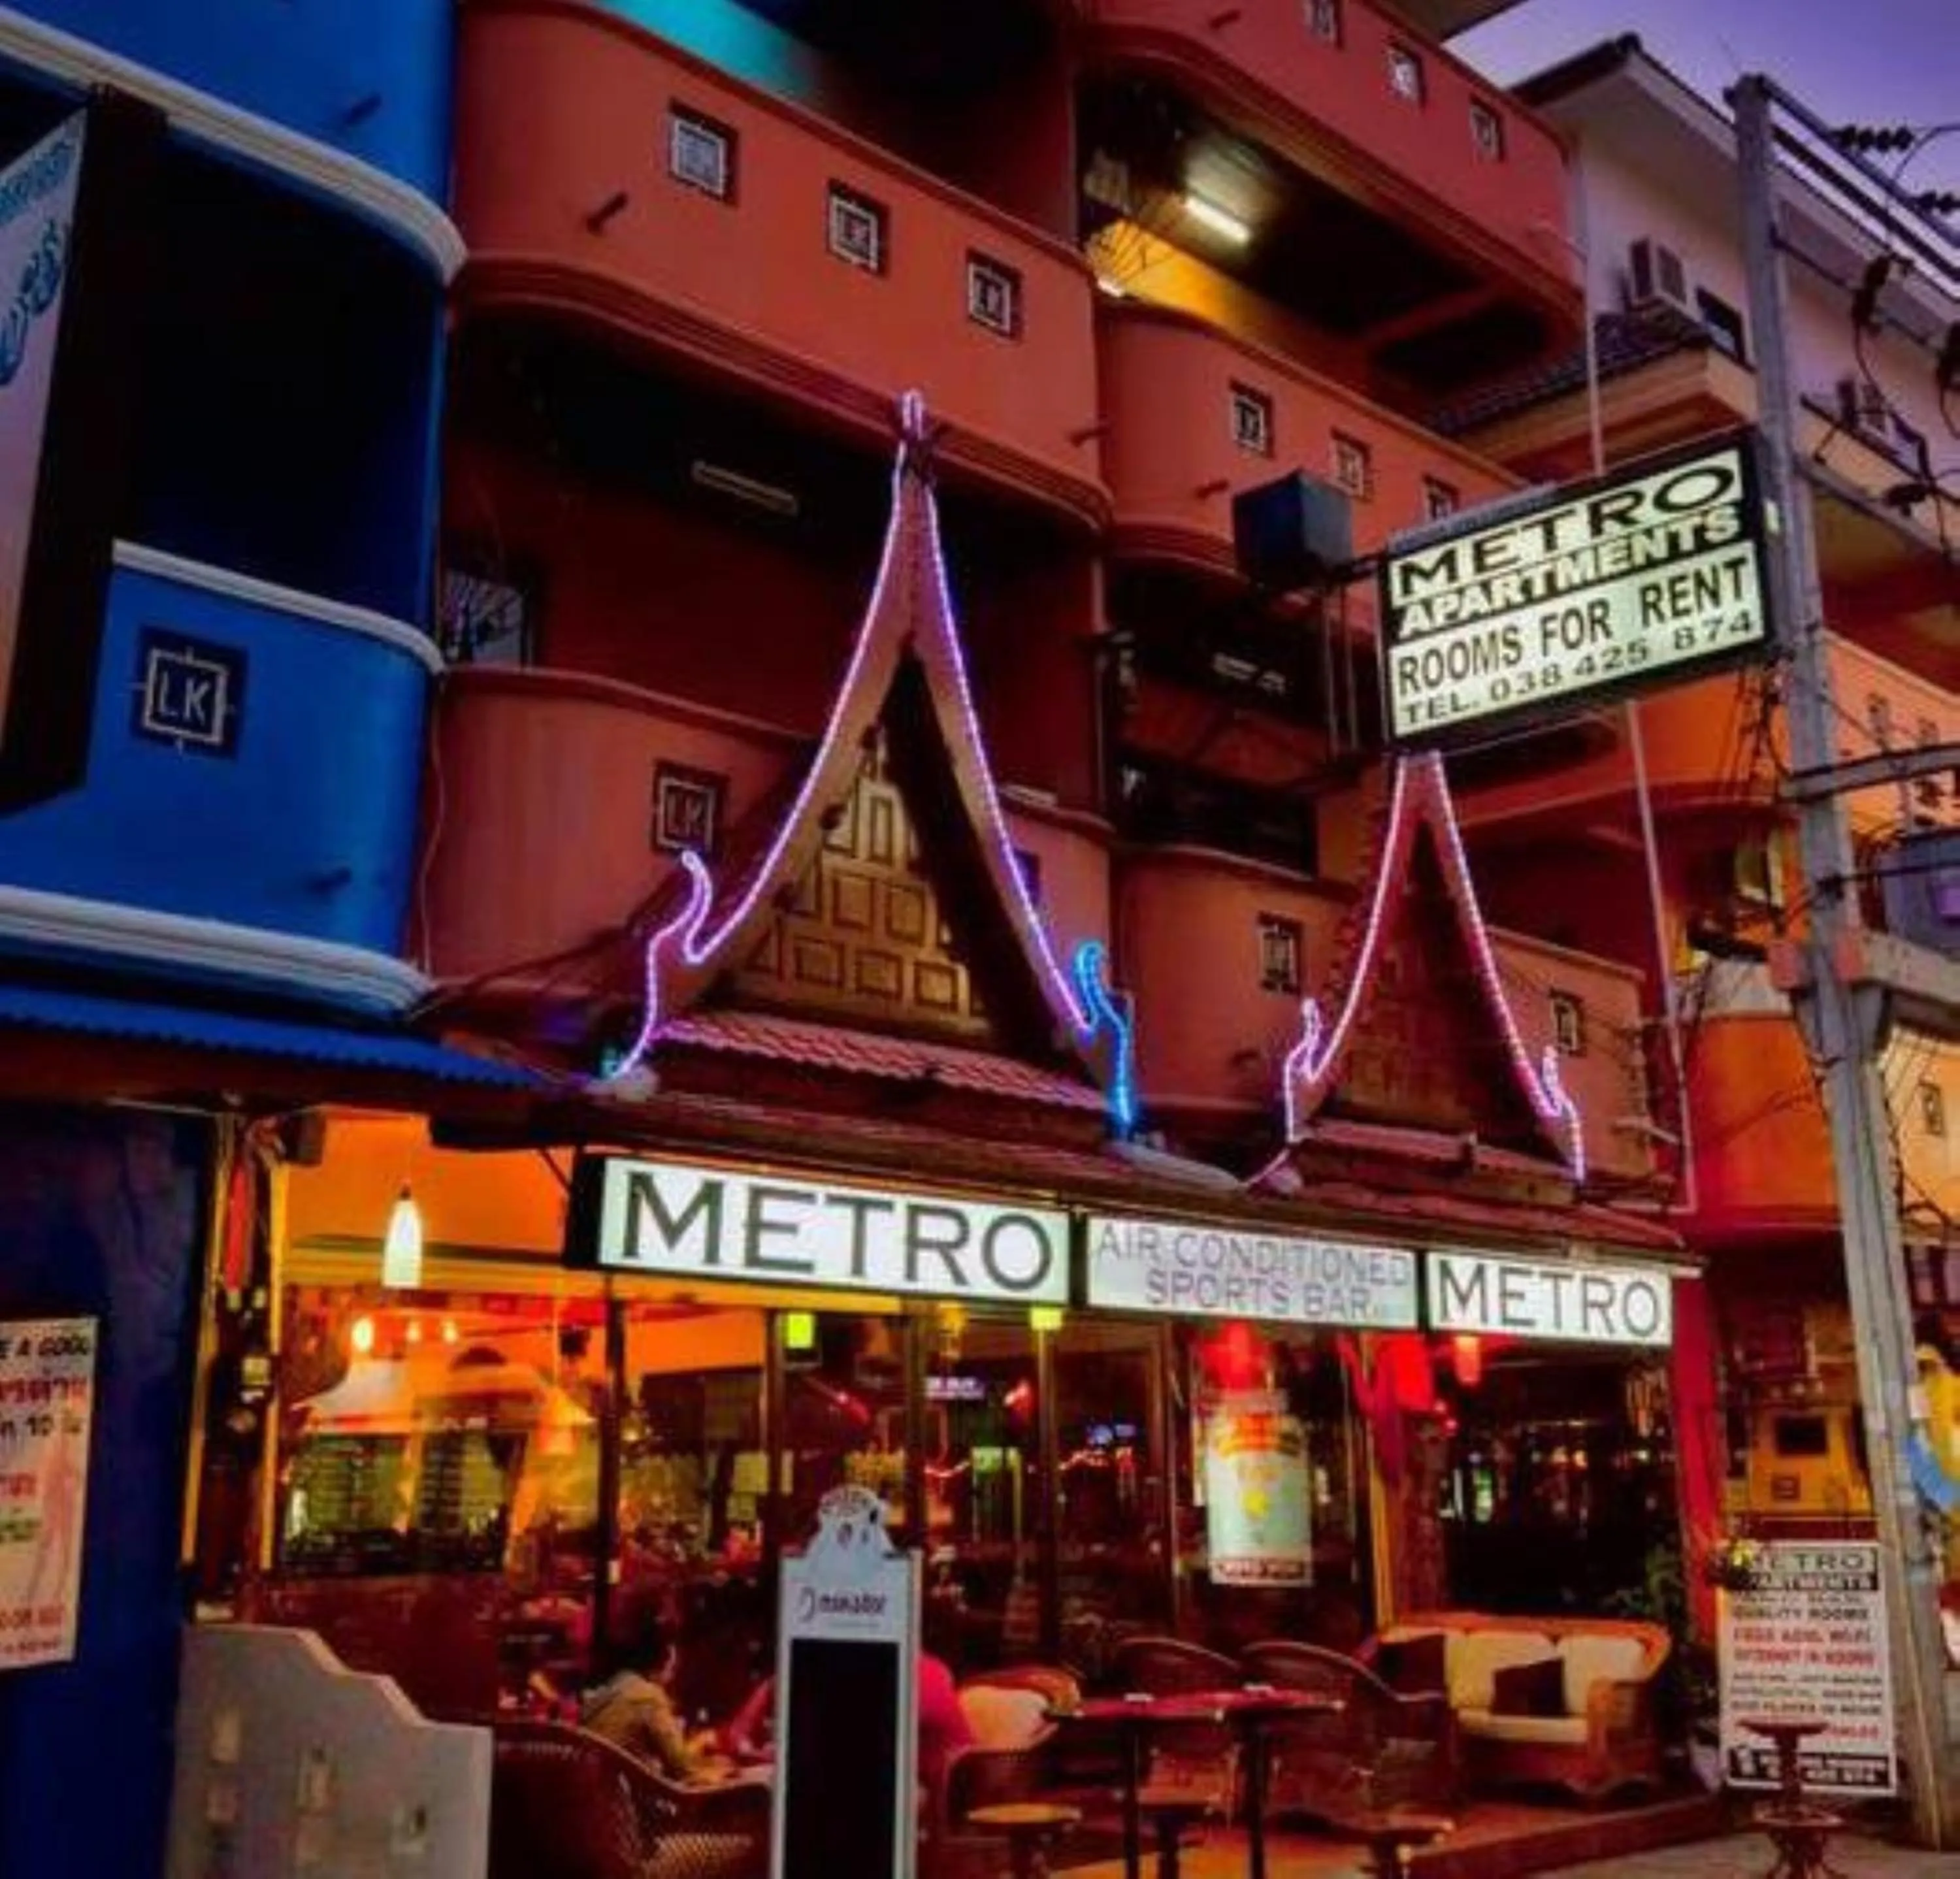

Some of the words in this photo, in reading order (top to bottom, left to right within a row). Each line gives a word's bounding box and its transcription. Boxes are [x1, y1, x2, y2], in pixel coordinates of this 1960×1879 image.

[1397, 502, 1741, 640] APARTMENTS
[1399, 466, 1734, 596] METRO
[1398, 626, 1524, 696] ROOMS
[1540, 598, 1612, 656] FOR
[1639, 557, 1748, 628] RENT
[1400, 690, 1480, 723] TEL.
[1490, 664, 1562, 701] 038
[1574, 638, 1648, 676] 425
[1674, 609, 1752, 650] 874
[623, 1170, 1053, 1291] METRO
[1097, 1223, 1161, 1263] AIR
[1175, 1231, 1408, 1286] CONDITIONED
[1146, 1268, 1290, 1315] SPORTS
[1439, 1260, 1660, 1334] METRO
